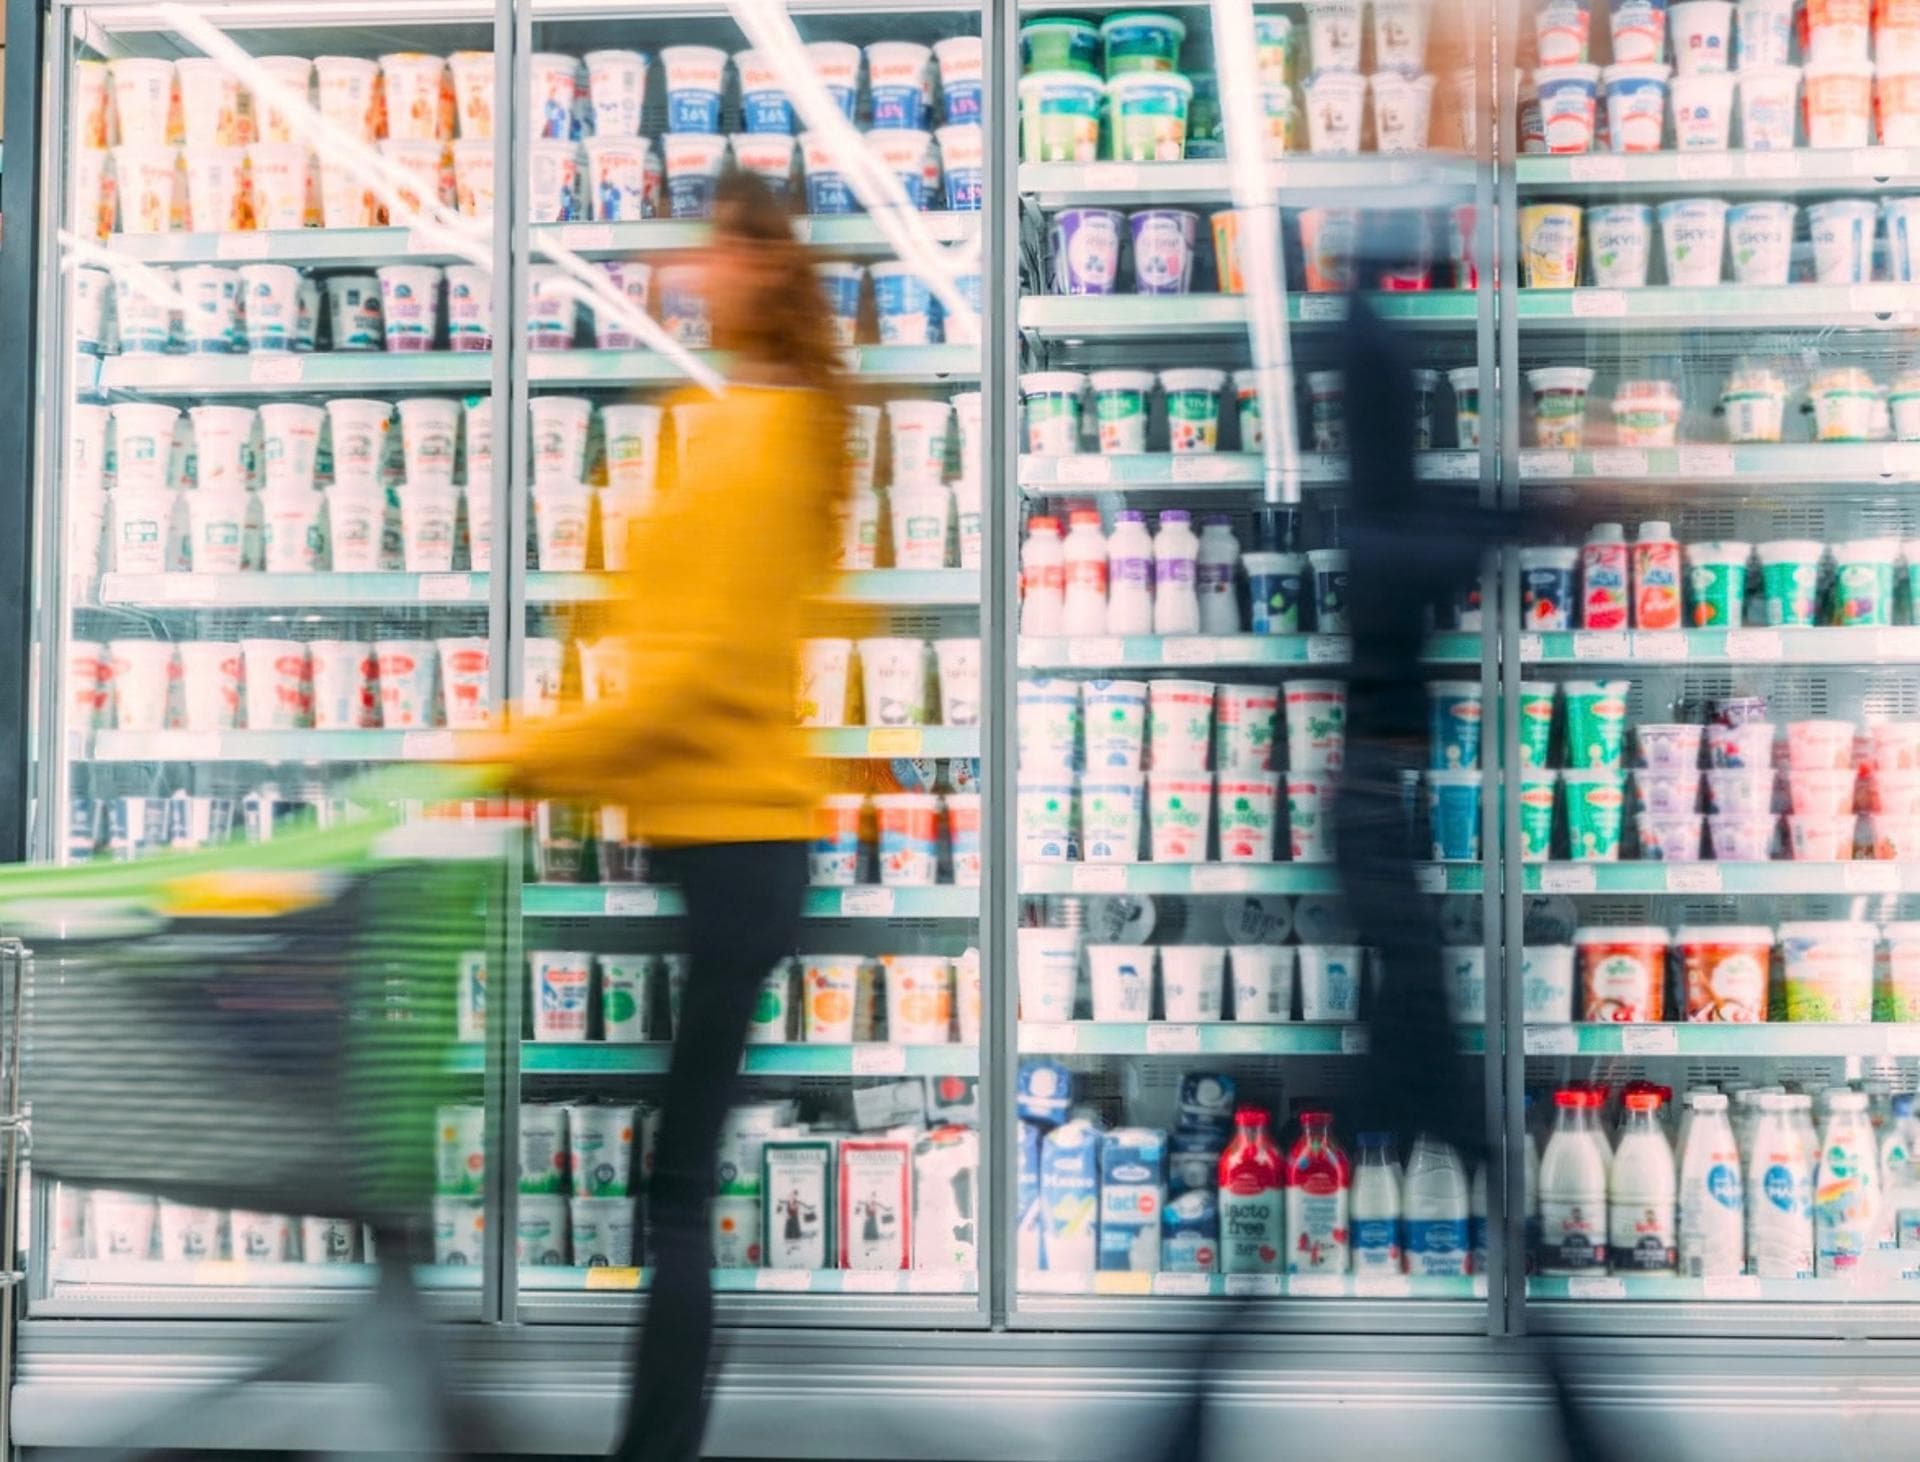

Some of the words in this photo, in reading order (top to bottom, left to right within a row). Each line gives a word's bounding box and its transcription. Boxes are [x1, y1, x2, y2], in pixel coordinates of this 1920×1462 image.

[680, 108, 708, 123] 3.6%
[757, 109, 786, 123] 3.6%
[1224, 1203, 1270, 1219] lacto
[1229, 1217, 1265, 1236] free
